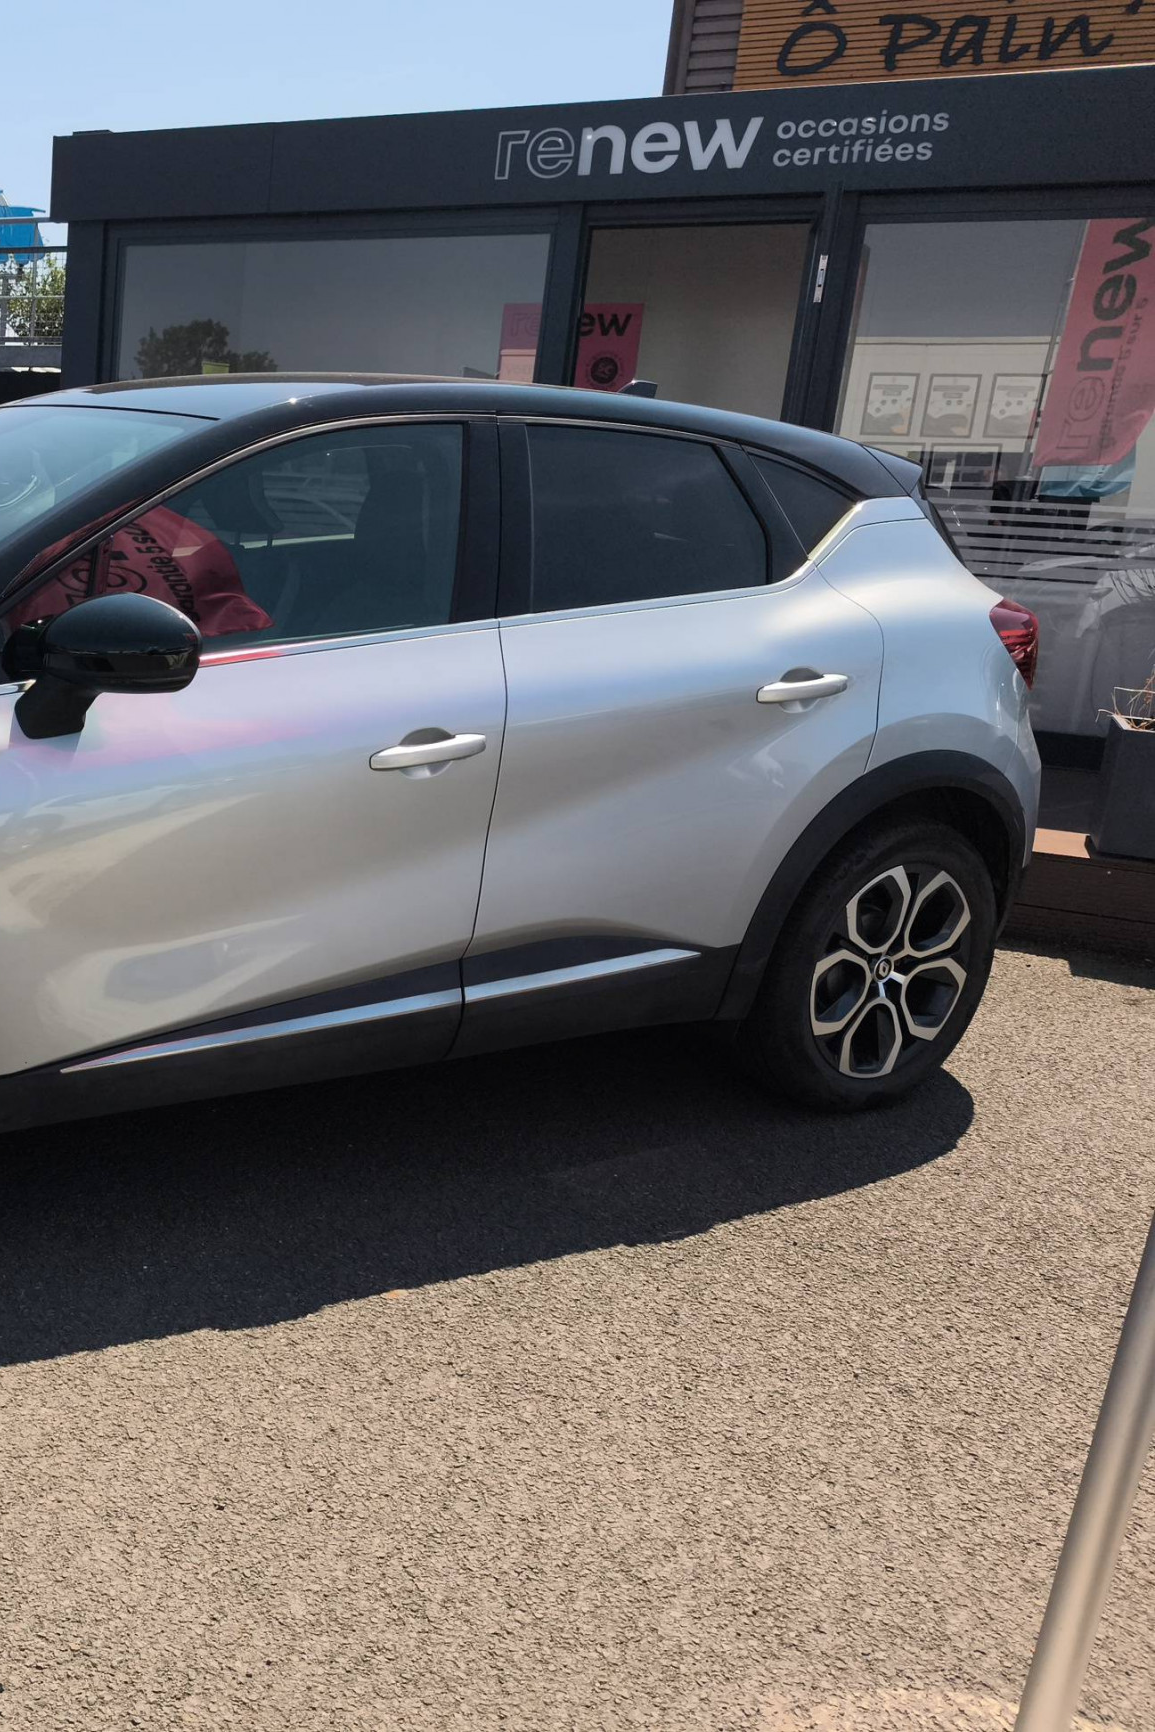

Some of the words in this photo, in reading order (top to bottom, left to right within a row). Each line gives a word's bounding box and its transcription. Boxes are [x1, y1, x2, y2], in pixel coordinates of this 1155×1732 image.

[776, 109, 950, 140] occasions
[494, 115, 765, 181] renew
[772, 137, 934, 168] certifiées
